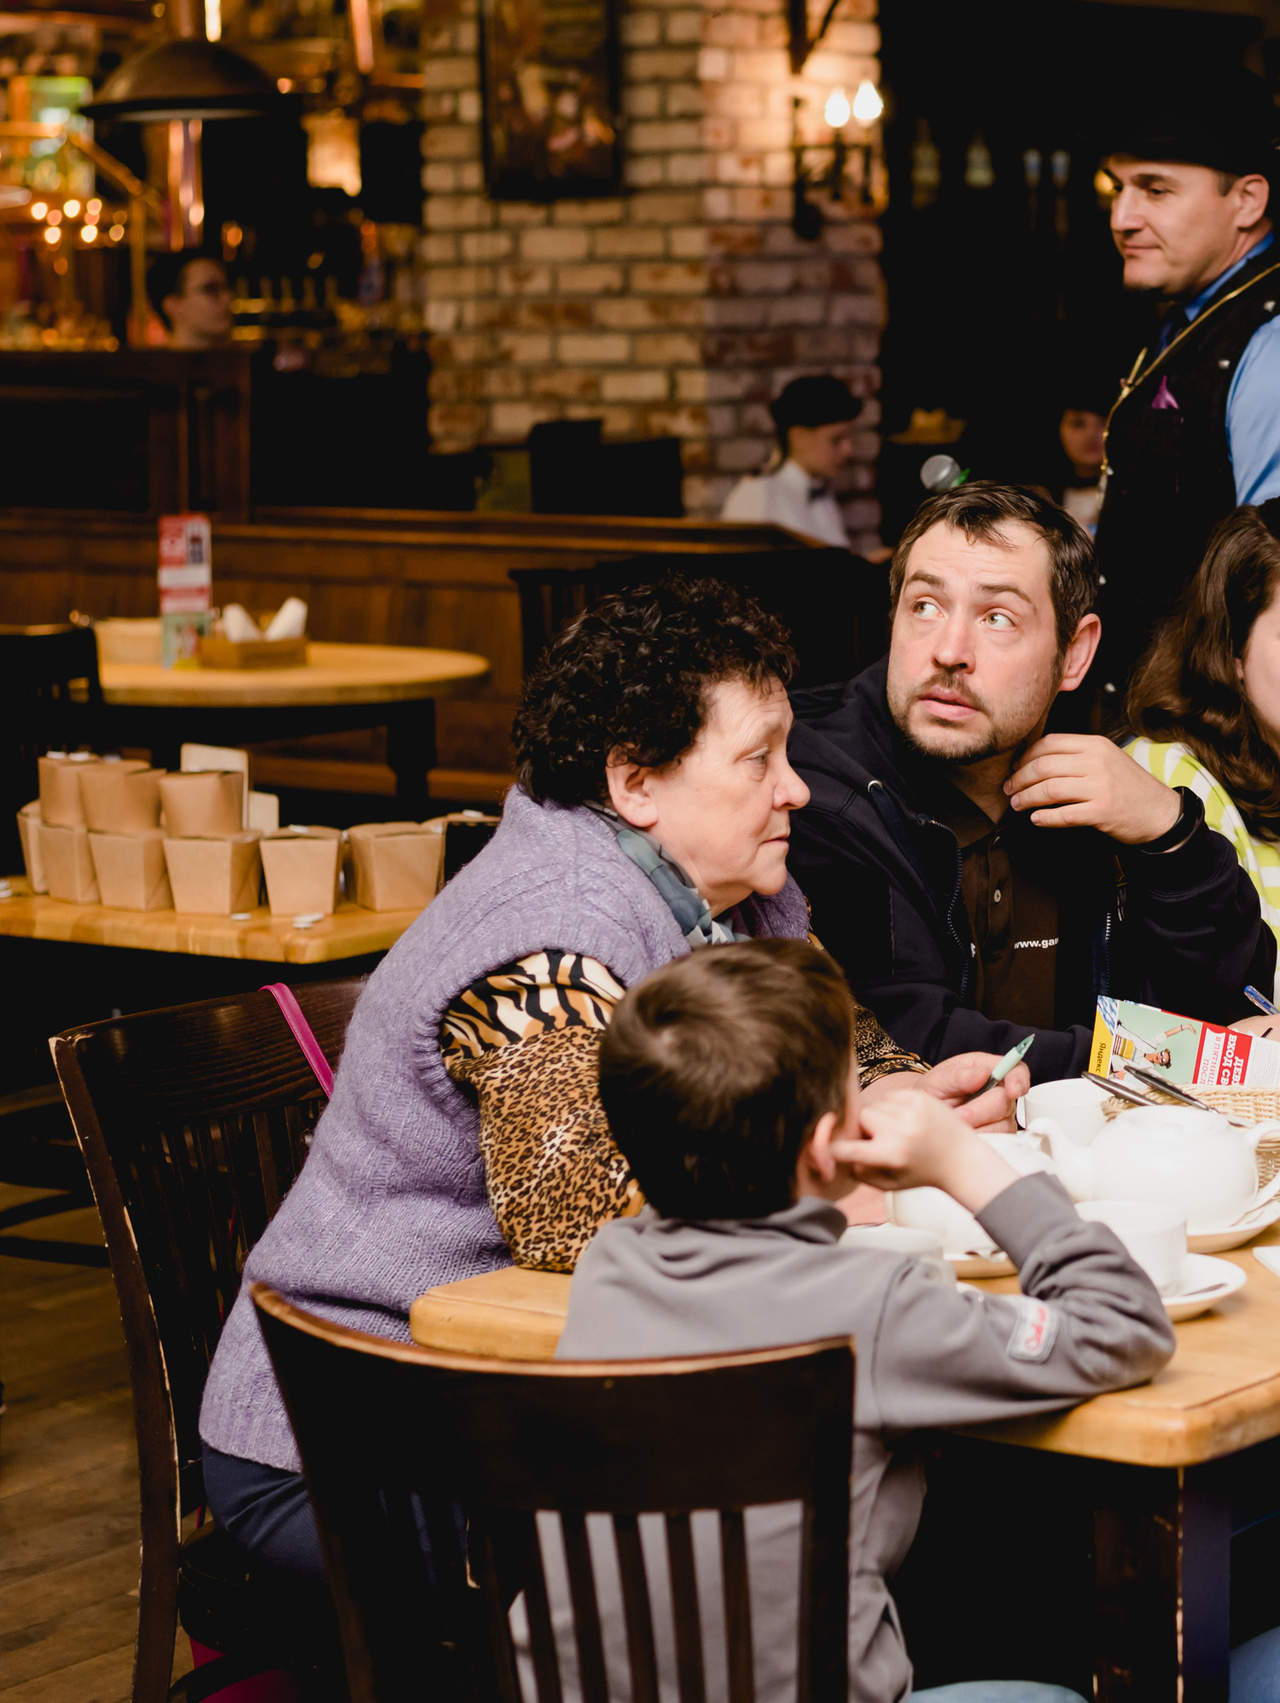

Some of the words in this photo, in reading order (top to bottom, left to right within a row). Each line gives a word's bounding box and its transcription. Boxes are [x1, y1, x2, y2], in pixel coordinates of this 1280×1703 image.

[1095, 1042, 1106, 1074] Яндекс
[1206, 1043, 1220, 1086] ПЯТНИЦ
[1222, 1033, 1238, 1068] ВХОД
